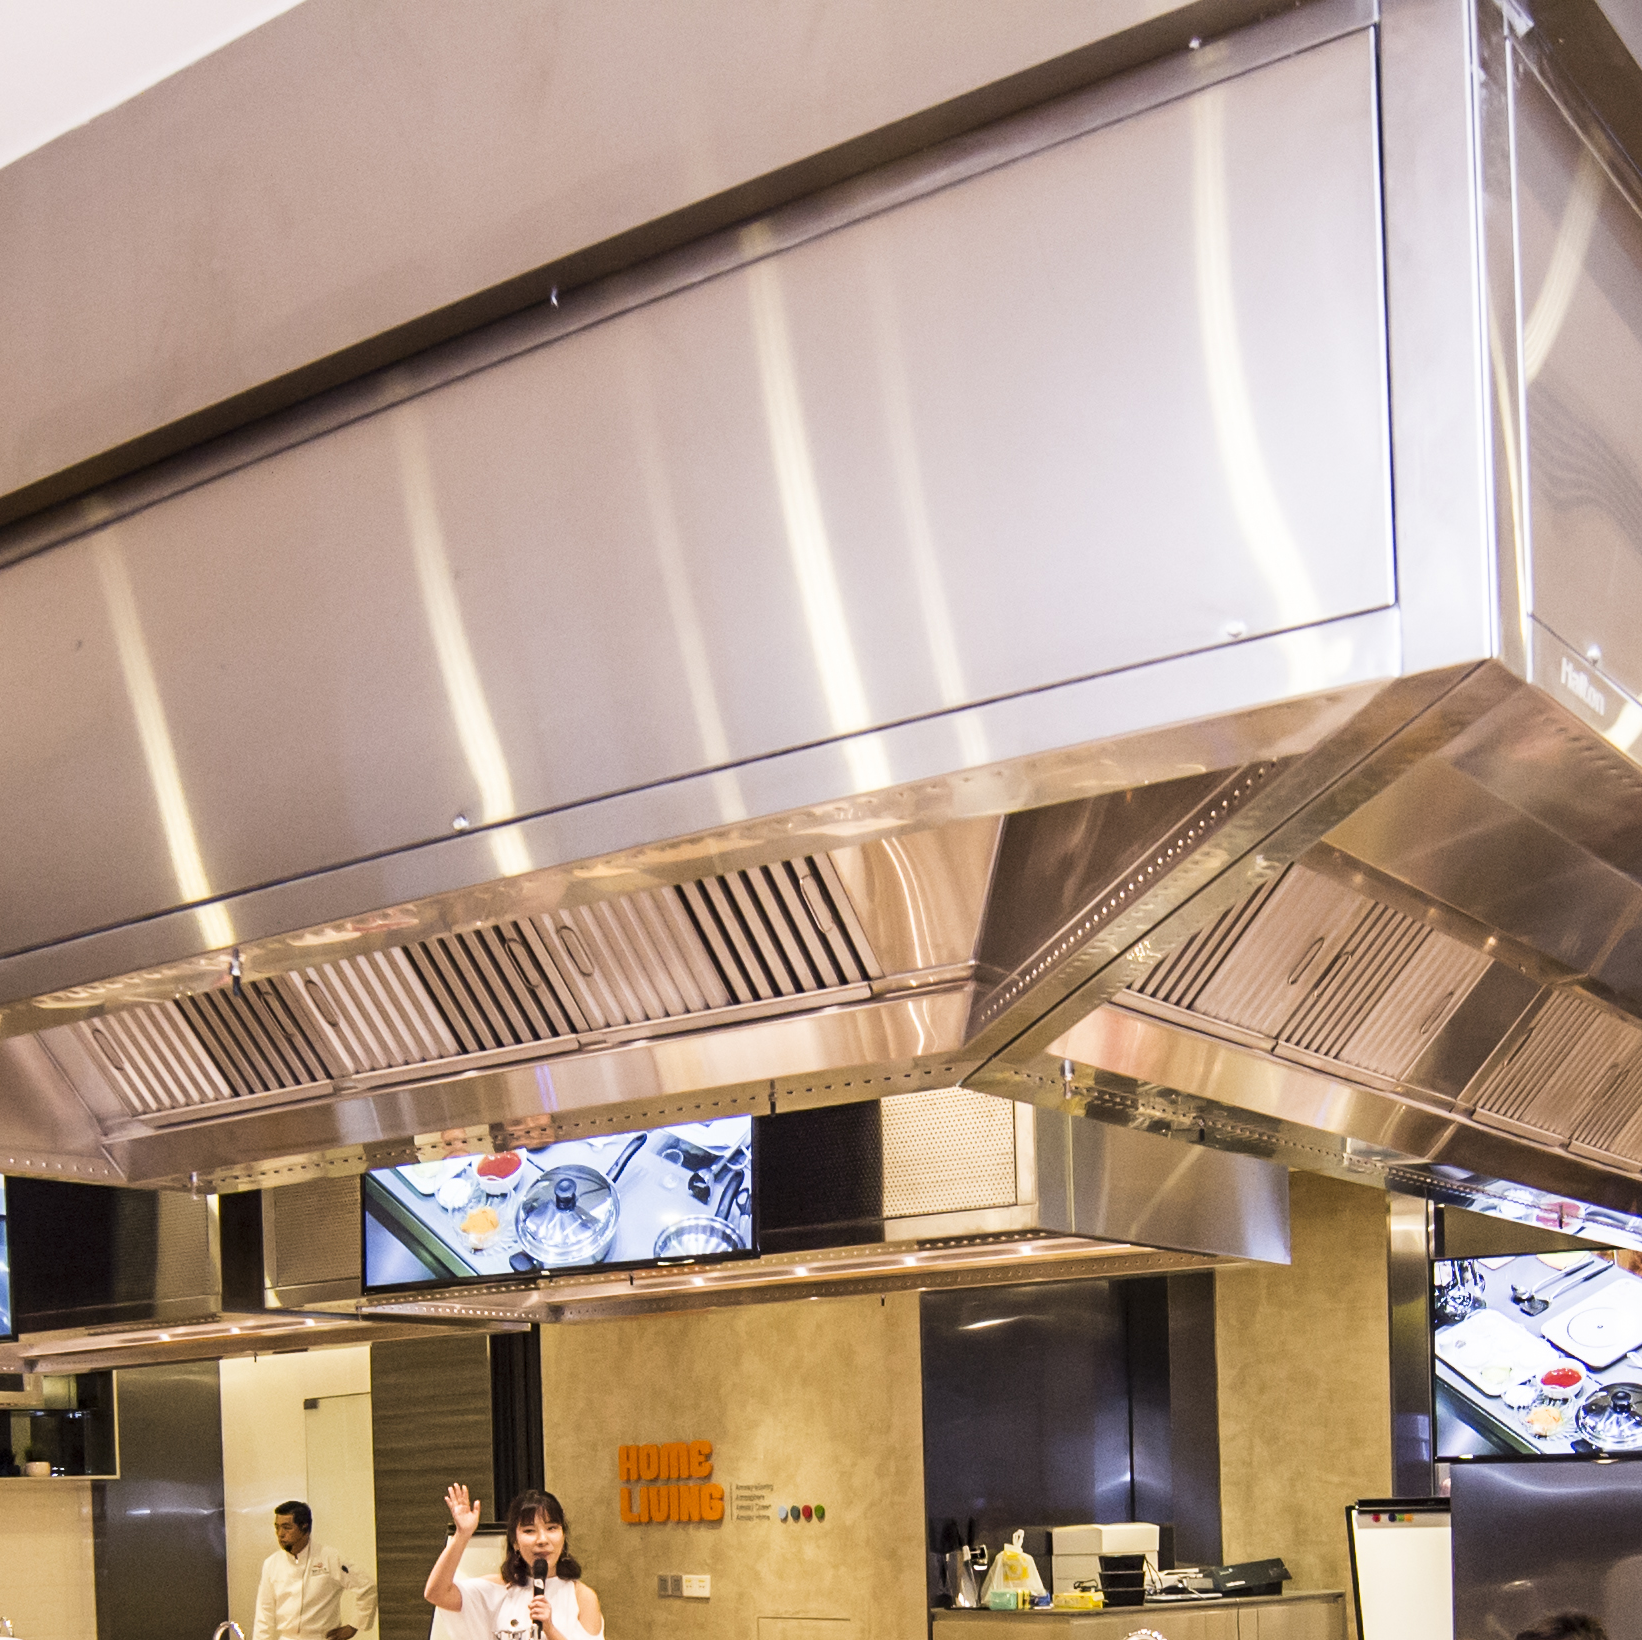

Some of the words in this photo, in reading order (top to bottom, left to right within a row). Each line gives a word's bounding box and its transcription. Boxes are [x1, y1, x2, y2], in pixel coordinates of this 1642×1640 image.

[1560, 656, 1605, 716] Halton
[618, 1439, 713, 1481] HOME
[620, 1483, 725, 1523] LIVING
